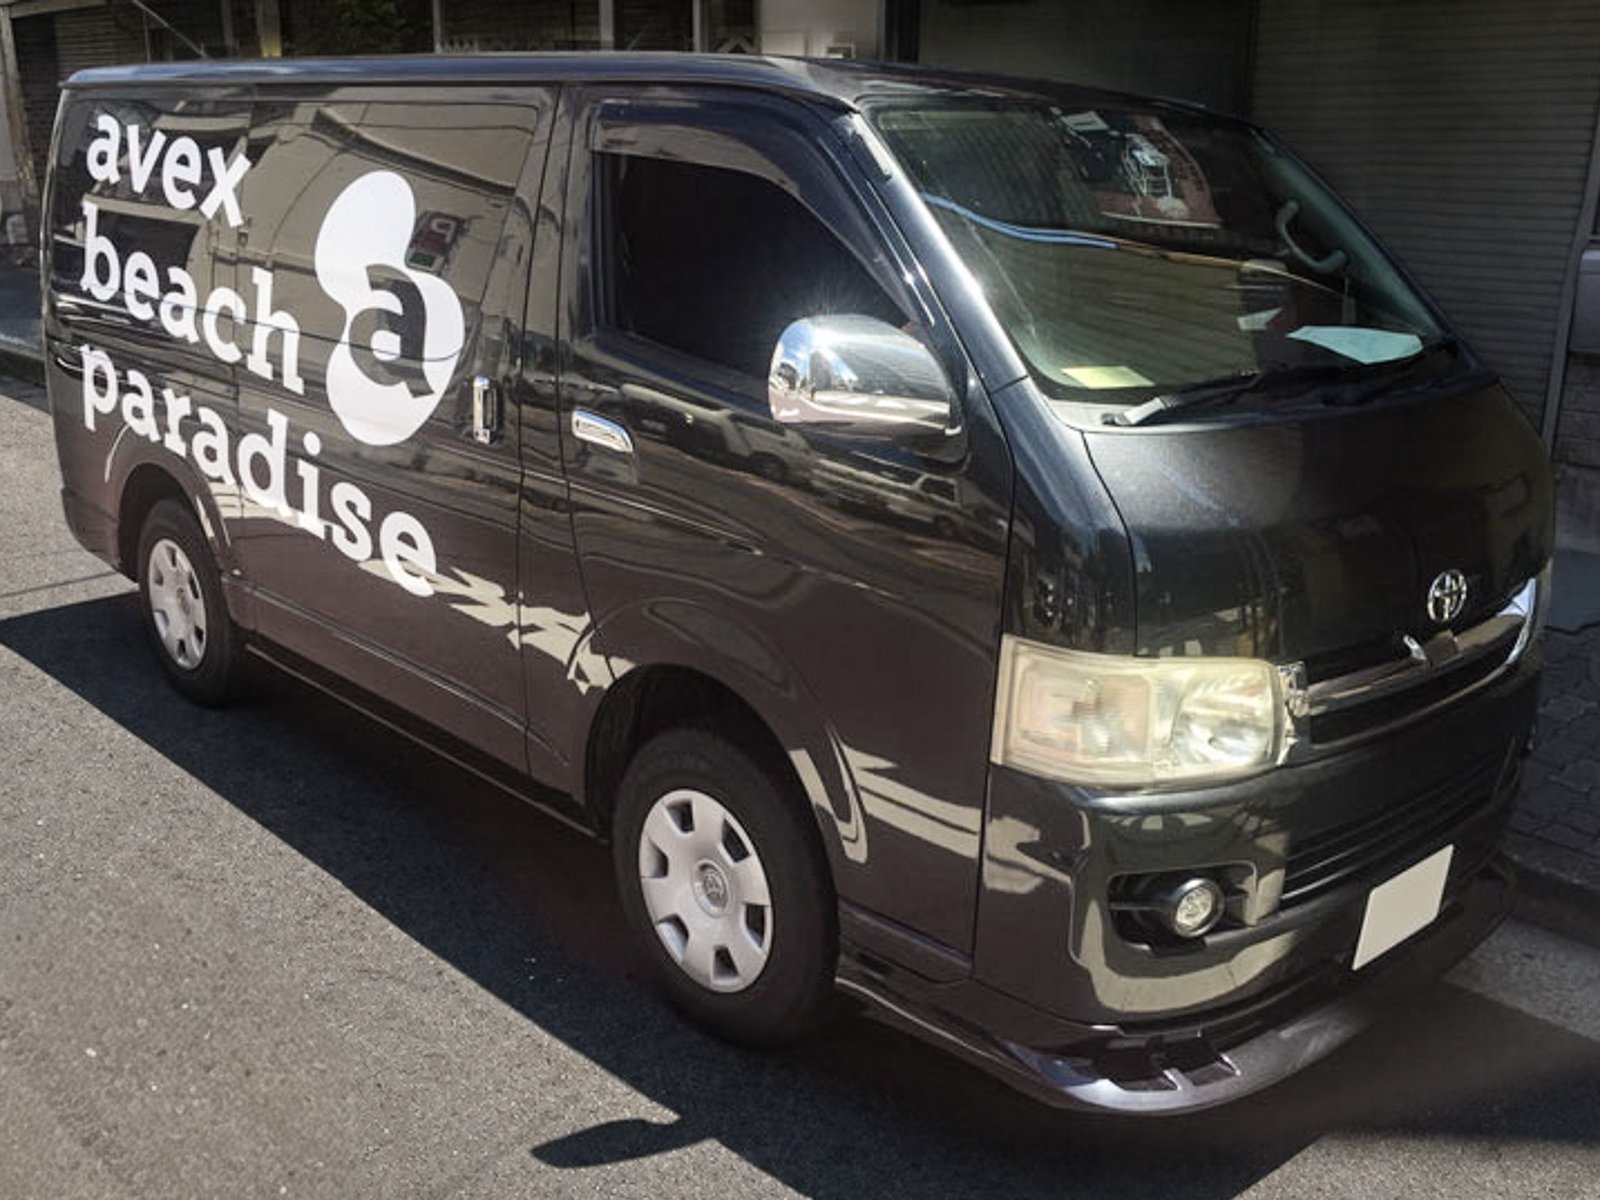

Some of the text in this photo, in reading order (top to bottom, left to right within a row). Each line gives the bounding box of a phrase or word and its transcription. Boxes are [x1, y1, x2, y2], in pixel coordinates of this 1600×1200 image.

[86, 114, 252, 227] avex
[81, 200, 305, 395] beach
[348, 262, 436, 400] a
[80, 344, 437, 598] paradise
